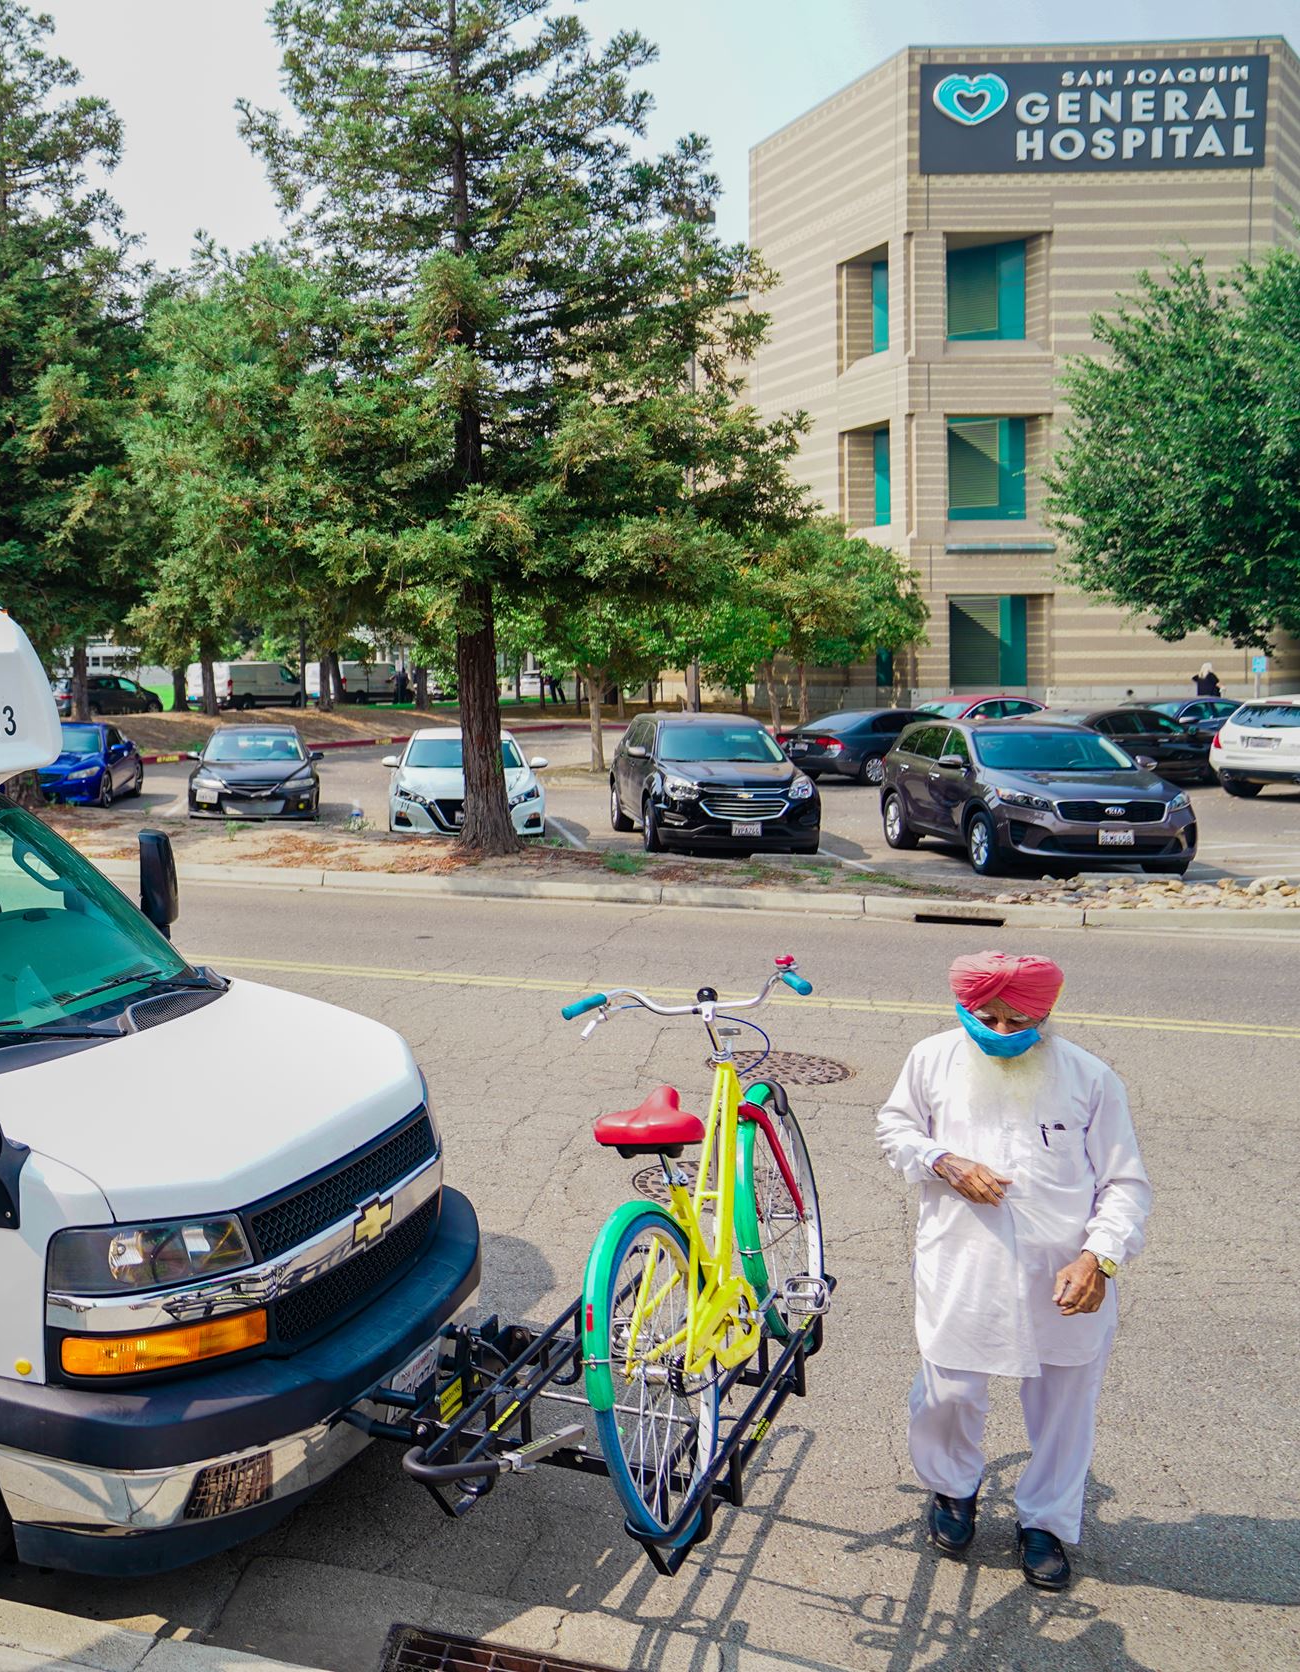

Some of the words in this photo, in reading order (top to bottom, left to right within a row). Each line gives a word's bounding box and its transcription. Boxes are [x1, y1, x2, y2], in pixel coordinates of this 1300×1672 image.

[1061, 69, 1114, 87] SAN
[1123, 65, 1249, 86] JOAQUIN
[1015, 86, 1255, 125] GENERAL
[1015, 124, 1255, 161] HOSPITAL
[1107, 806, 1125, 816] KIA
